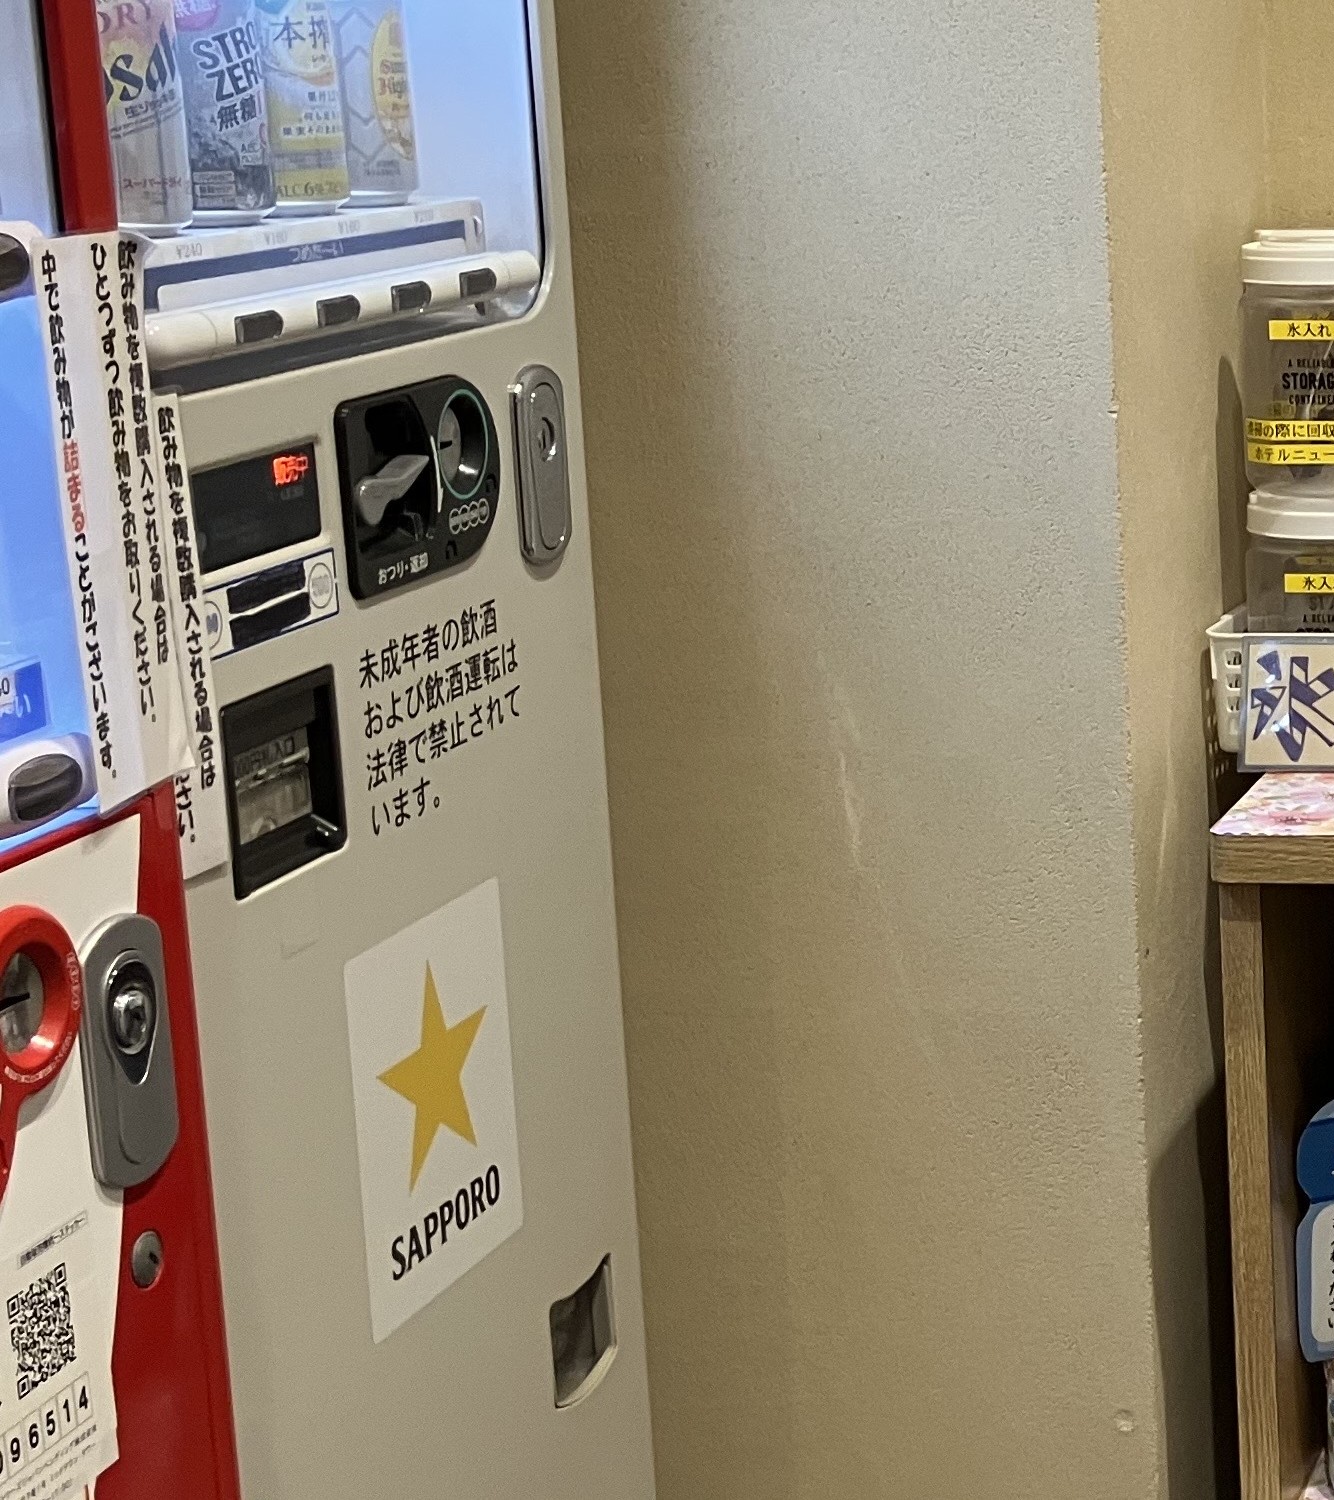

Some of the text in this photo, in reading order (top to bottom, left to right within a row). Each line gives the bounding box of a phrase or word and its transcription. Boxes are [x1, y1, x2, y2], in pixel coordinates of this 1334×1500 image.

[91, 243, 156, 722] ひとつずつ飲み物をお取りください。
[118, 240, 169, 664] 飲み物を複数購入される場合は
[359, 599, 498, 689] 未成年者の飲酒
[363, 640, 519, 739] および飲酒運転は
[366, 685, 521, 791] 法律で禁止されて
[371, 778, 441, 836] います。
[391, 1164, 501, 1281] SAPPORO
